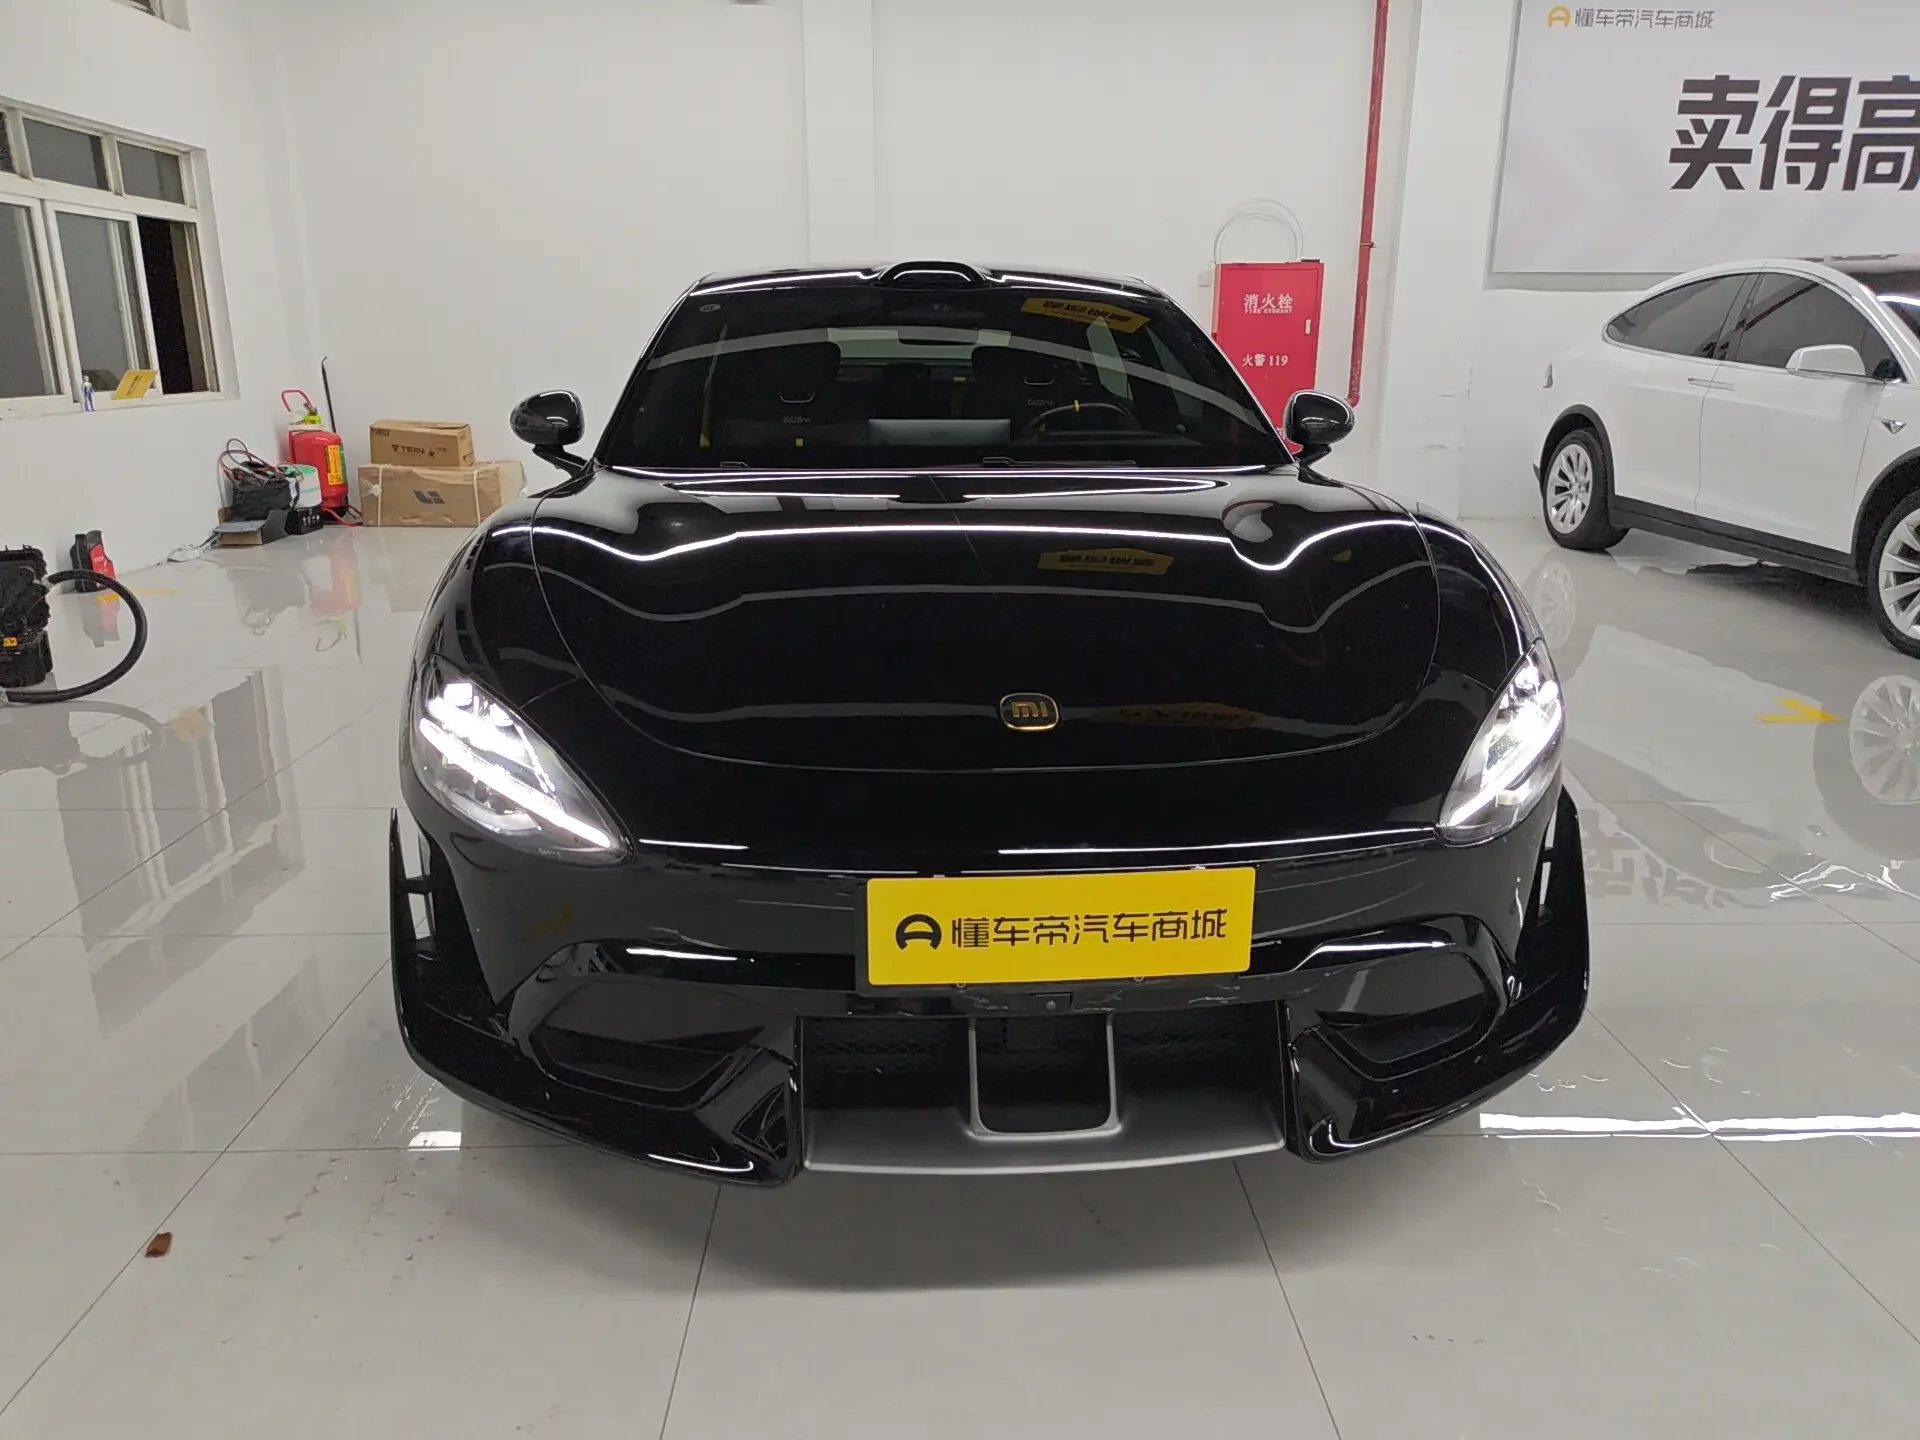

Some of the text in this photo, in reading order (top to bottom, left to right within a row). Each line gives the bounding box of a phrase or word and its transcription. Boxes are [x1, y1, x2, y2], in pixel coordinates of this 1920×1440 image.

[1574, 7, 1715, 29] 懂车帝汽车商城
[1669, 74, 1920, 191] 卖得高
[1243, 293, 1293, 309] 消火栓
[1242, 353, 1288, 367] 火警 119
[951, 907, 1228, 949] 懂车帝汽车商城
